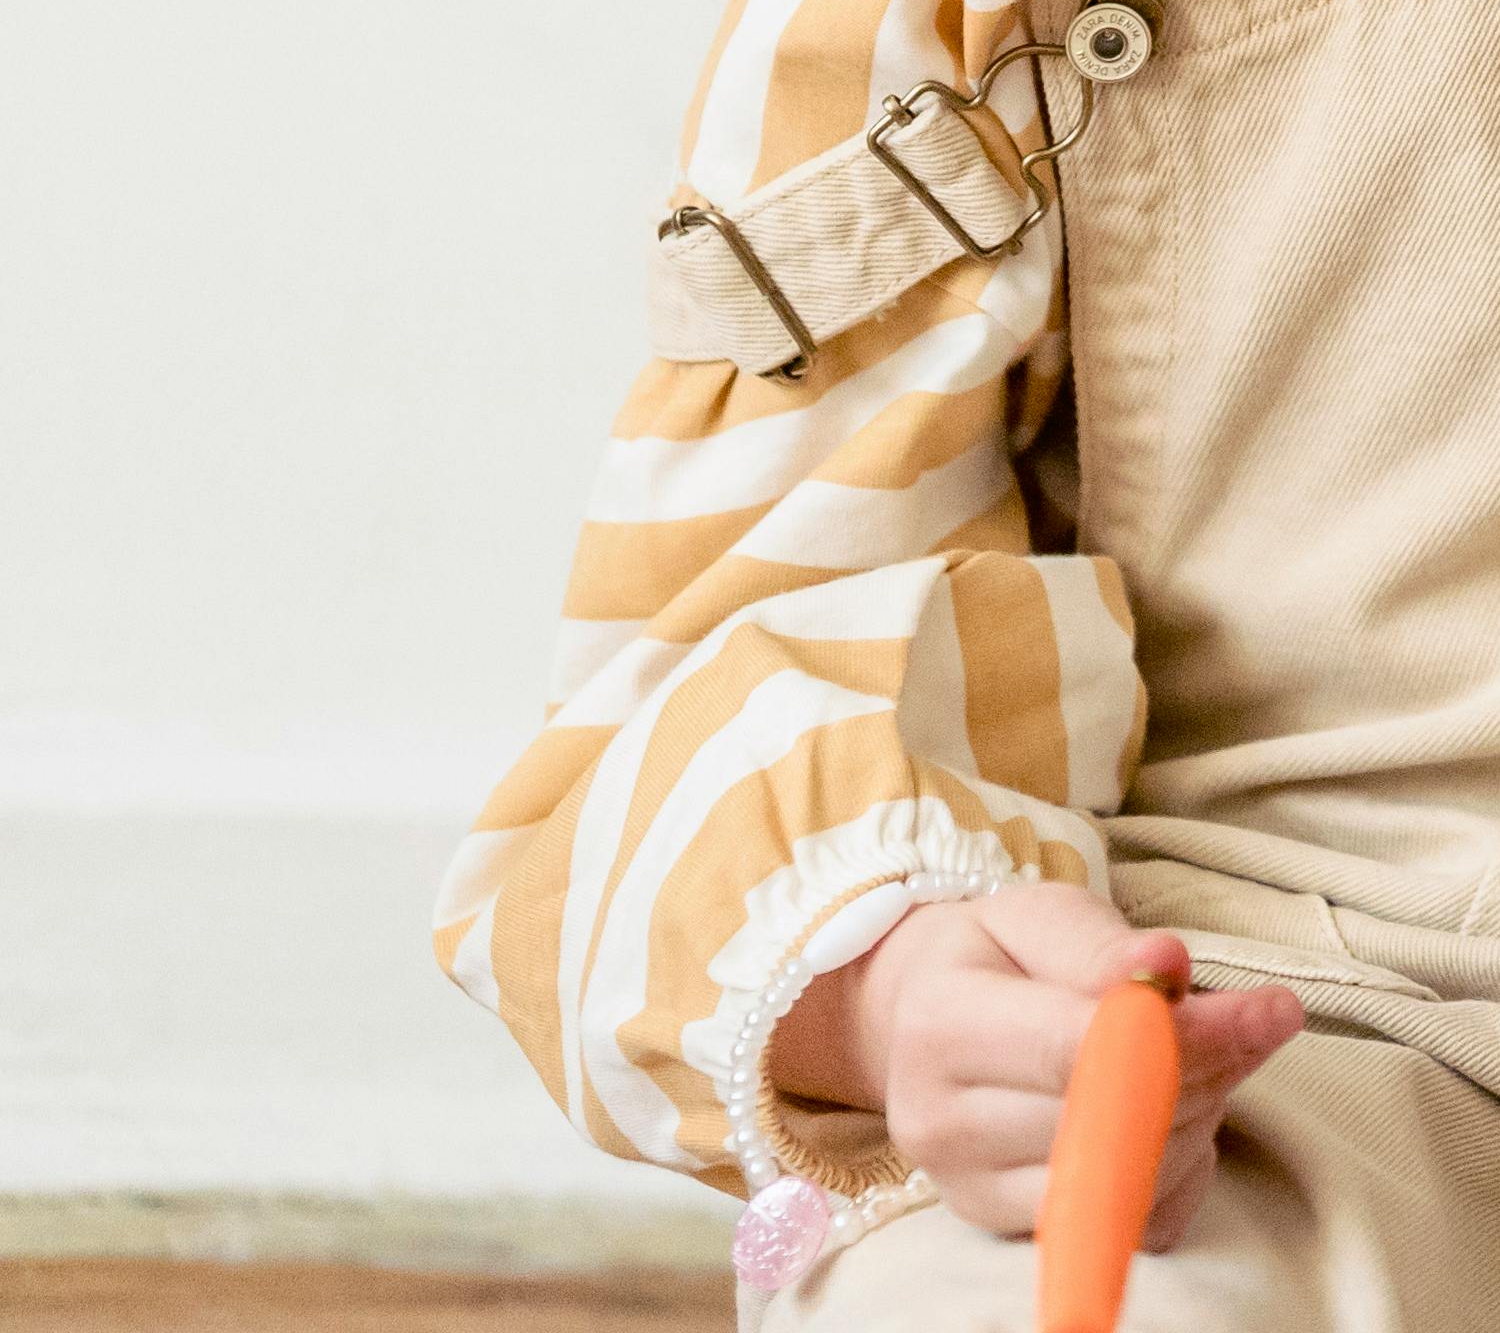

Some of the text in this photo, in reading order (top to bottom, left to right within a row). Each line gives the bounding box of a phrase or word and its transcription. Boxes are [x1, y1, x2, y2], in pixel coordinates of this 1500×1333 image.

[1076, 13, 1140, 41] ZARA DENIM
[1076, 50, 1142, 76] ZARA DENIM
